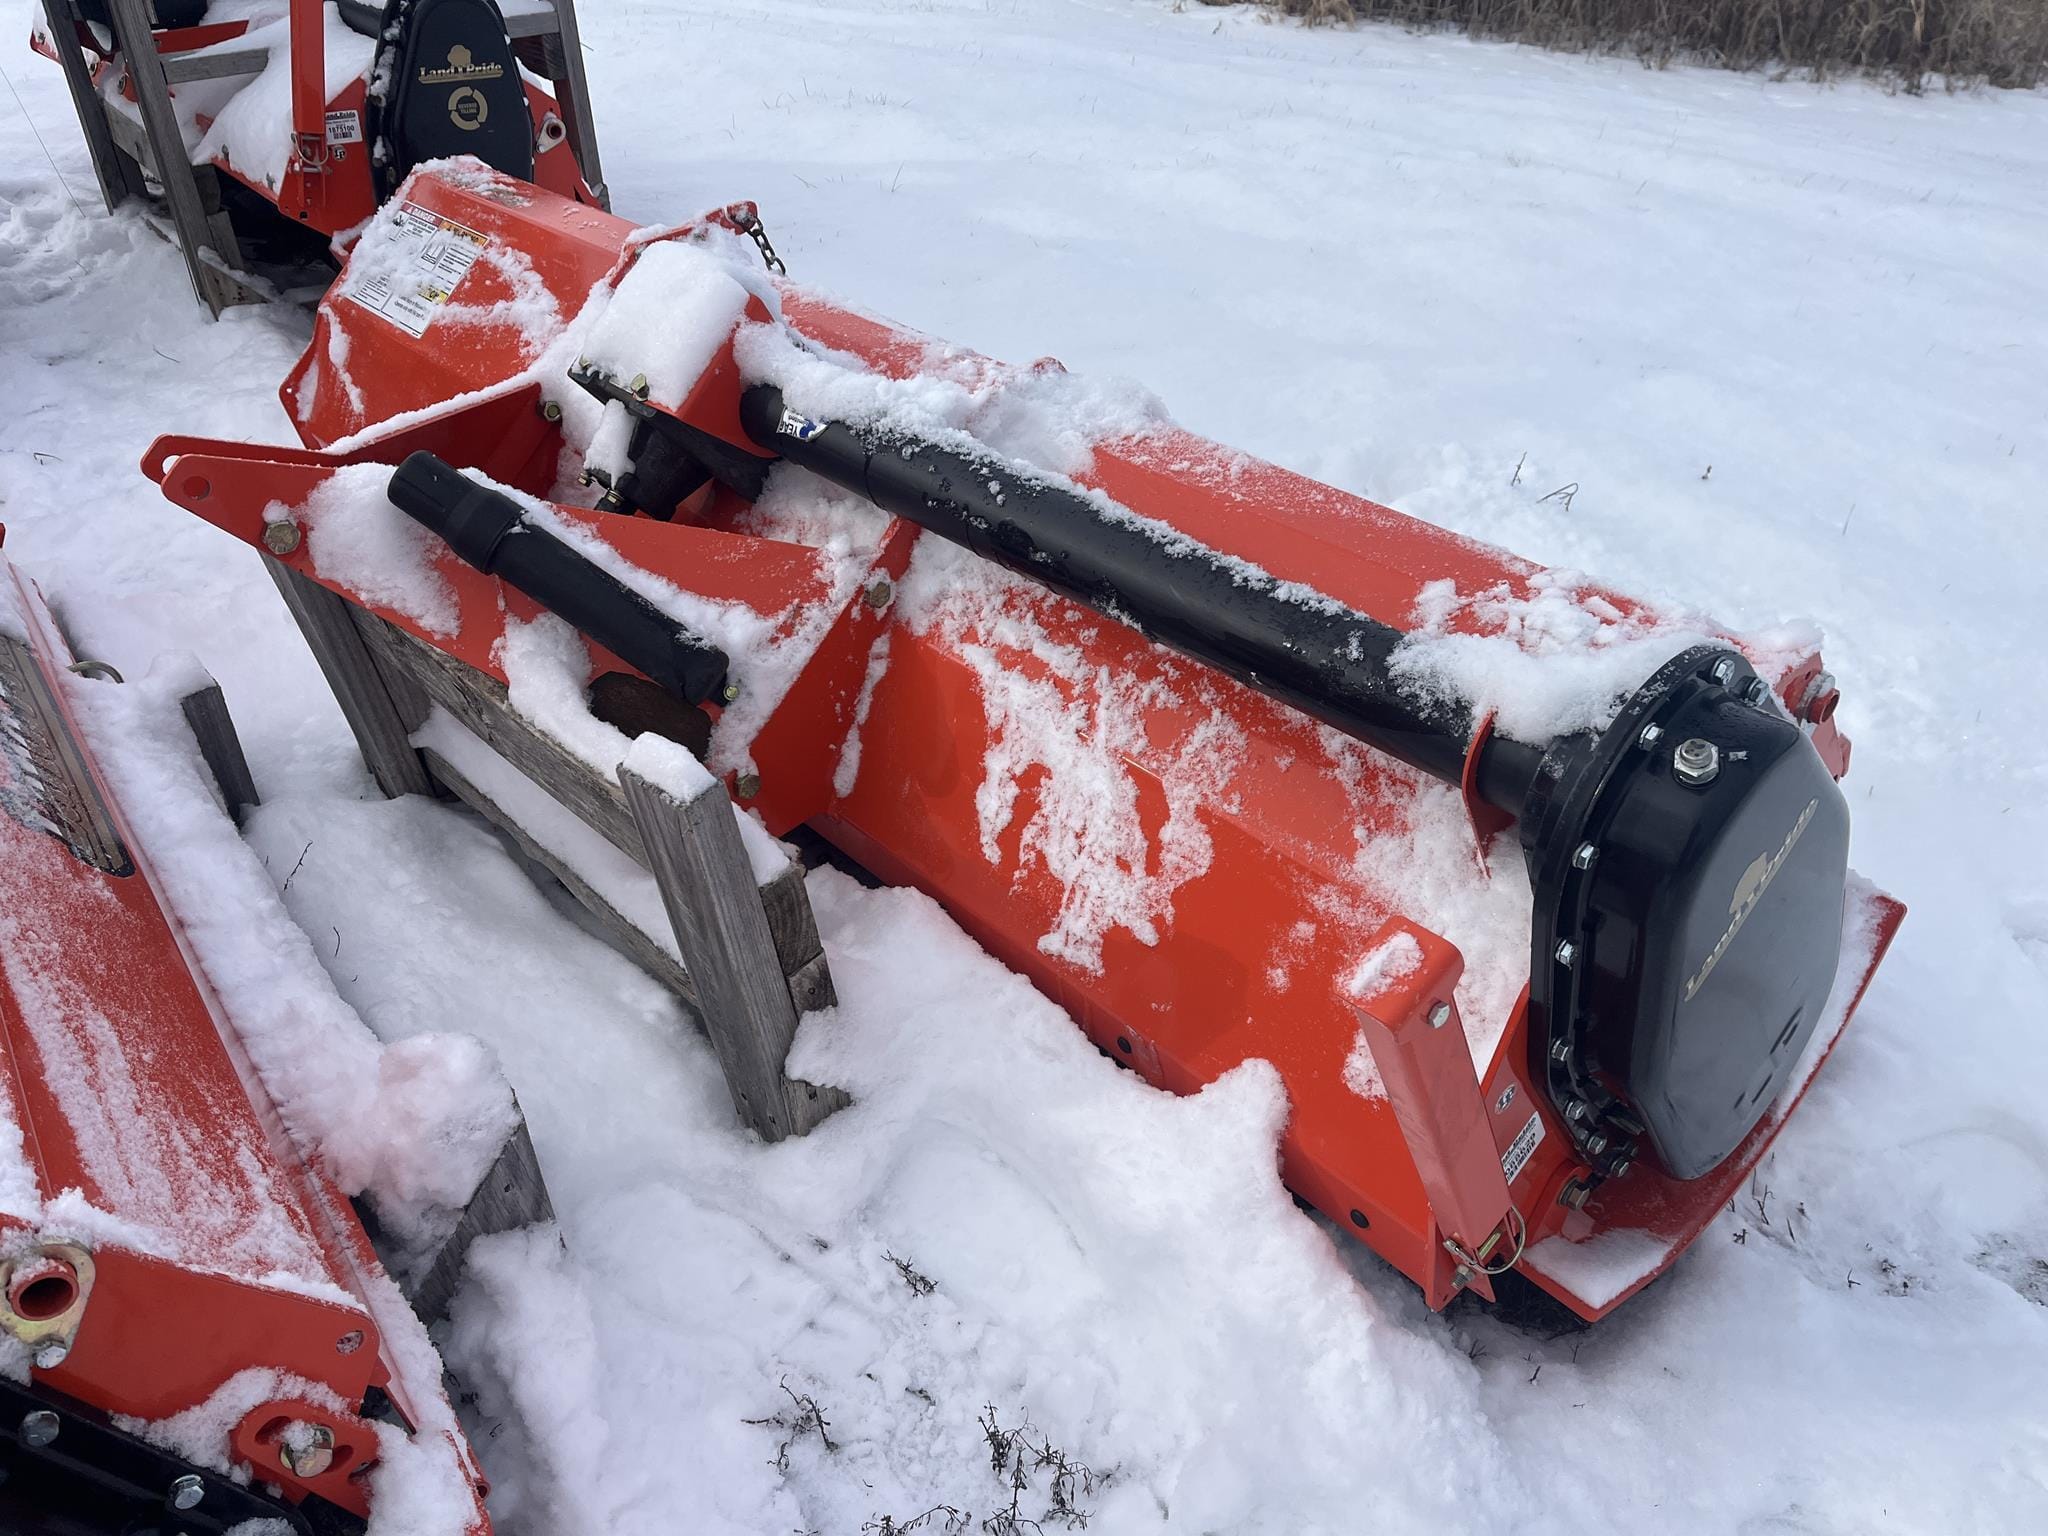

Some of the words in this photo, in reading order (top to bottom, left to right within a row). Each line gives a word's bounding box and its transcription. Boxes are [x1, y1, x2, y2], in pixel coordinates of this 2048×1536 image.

[420, 65, 455, 76] Land
[466, 62, 502, 73] Pride
[411, 207, 436, 223] DANGER
